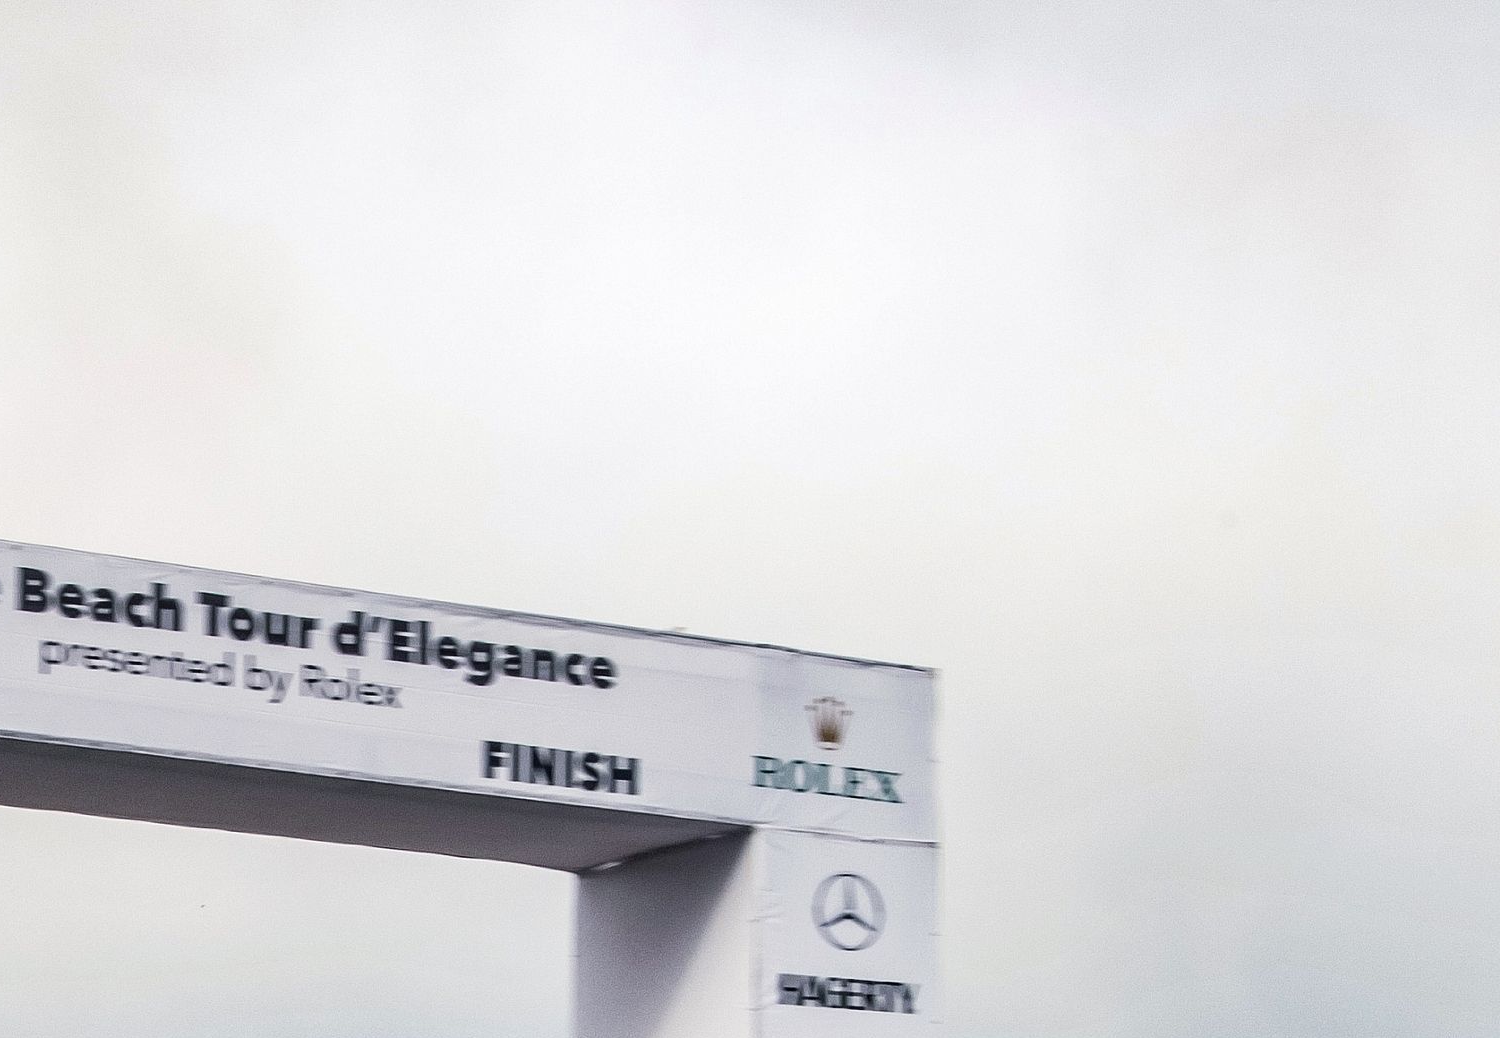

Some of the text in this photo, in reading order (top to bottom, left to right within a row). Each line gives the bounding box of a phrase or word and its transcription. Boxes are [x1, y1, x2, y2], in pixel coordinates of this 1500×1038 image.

[15, 566, 185, 632] Beach
[195, 590, 320, 650] Tour
[38, 639, 404, 709] presented by Rolex
[481, 739, 641, 796] FINISH
[751, 754, 905, 804] ROLEX
[777, 972, 920, 1015] HAGERTY
